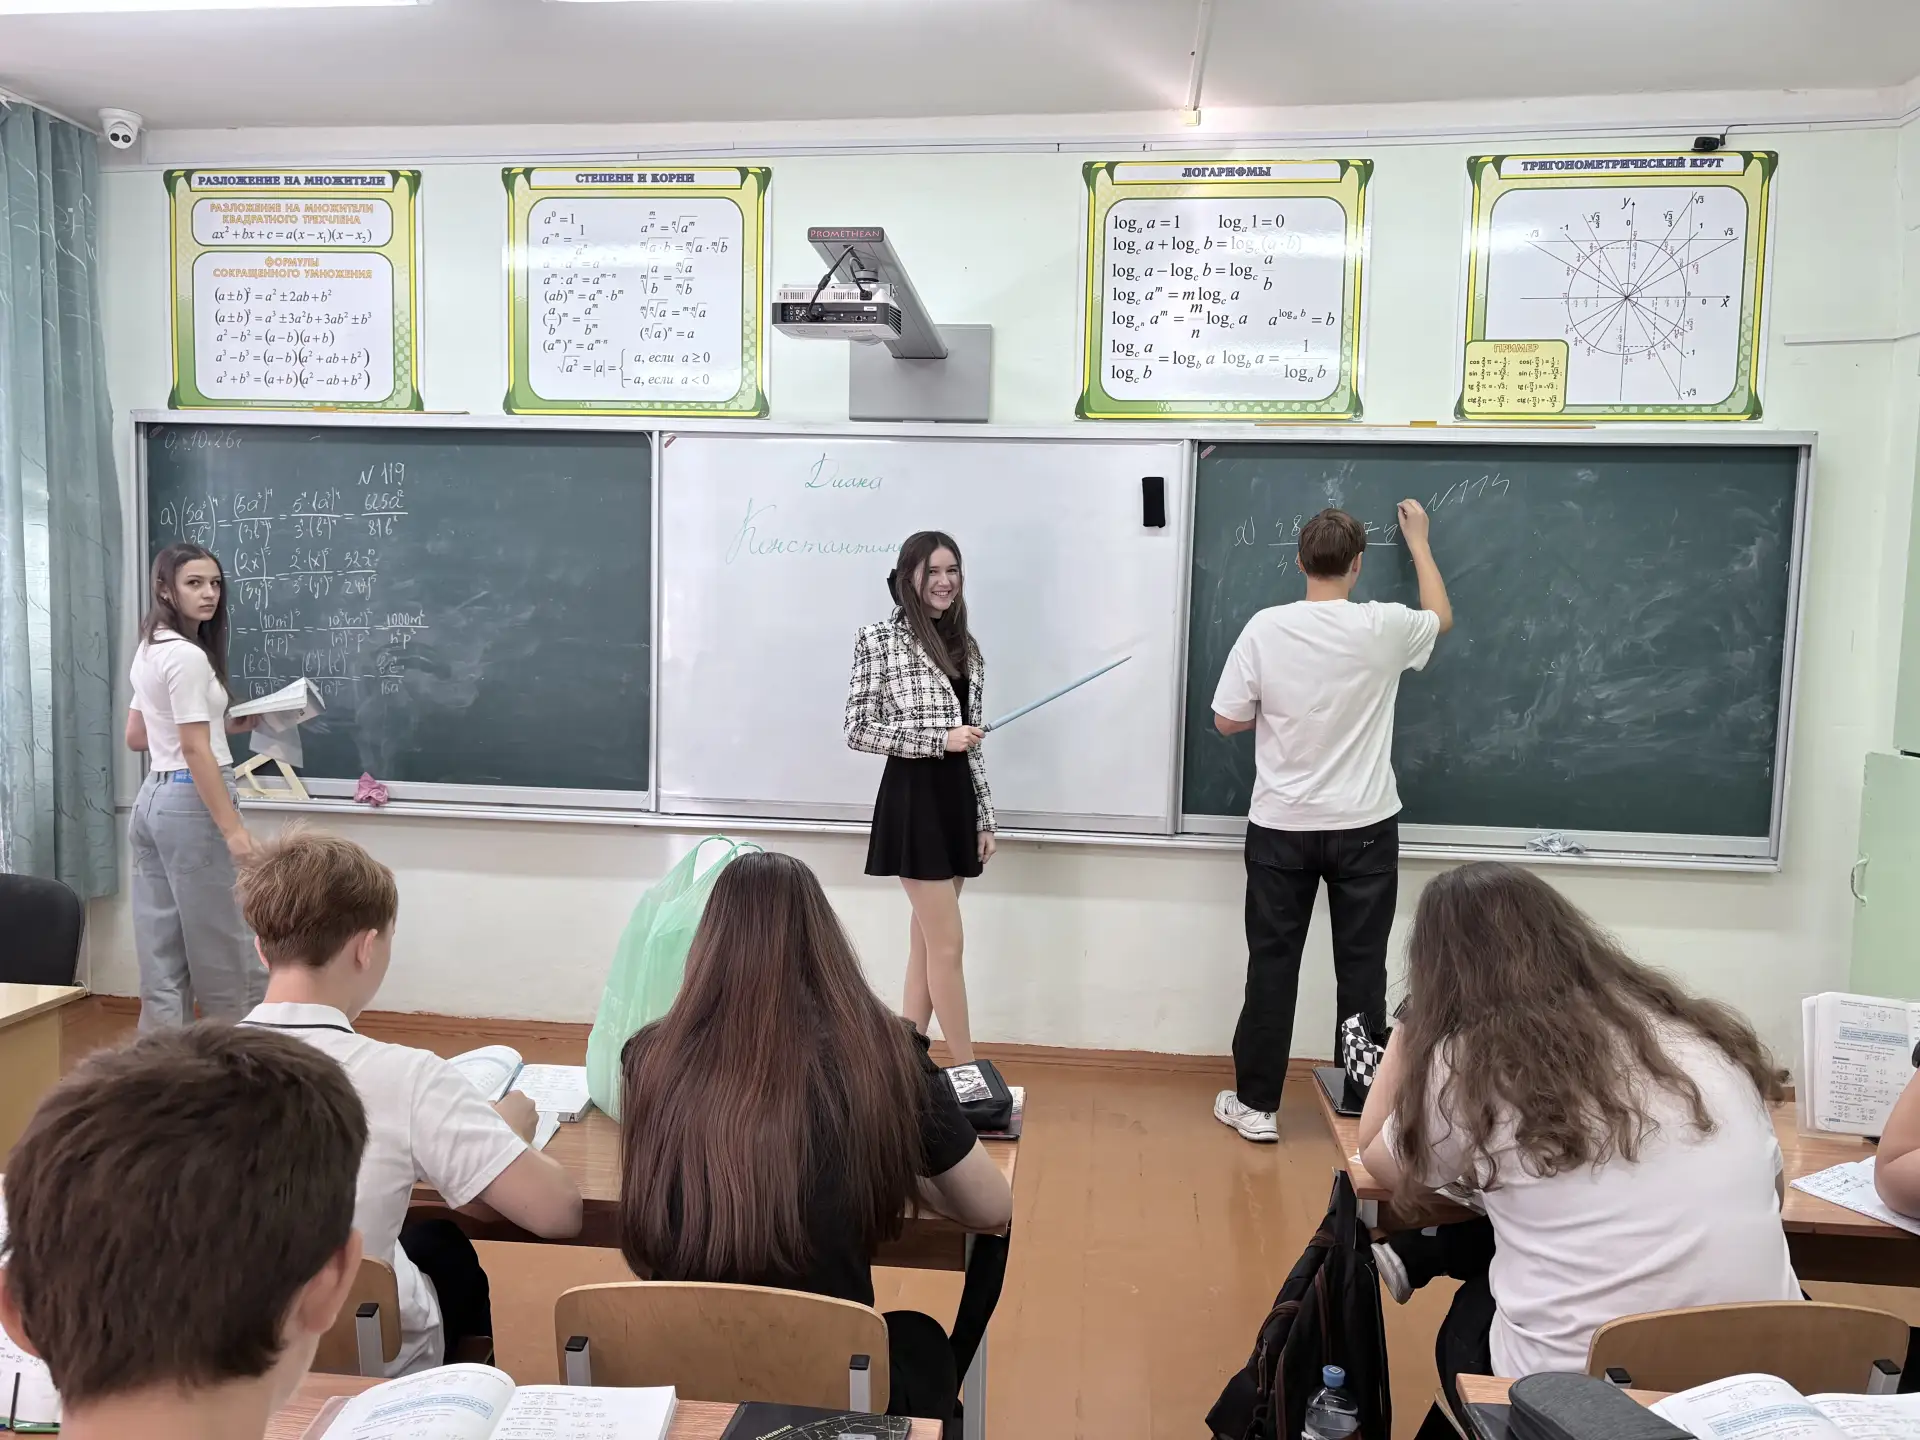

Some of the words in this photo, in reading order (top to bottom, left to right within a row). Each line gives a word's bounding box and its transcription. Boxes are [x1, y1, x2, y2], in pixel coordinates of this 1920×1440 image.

[1522, 158, 1685, 171] ТРИГОНОМЕТРИЧЕСКИЙ
[1689, 158, 1723, 168] КРУГ
[1182, 167, 1271, 177] ЛОГАРИФМЫ
[198, 176, 280, 185] РАЗЛОЖЕНИЕ
[284, 177, 300, 185] НА
[304, 176, 385, 186] МНОЖИТЕЛИ
[575, 174, 634, 183] СТЕПЕНИ
[638, 174, 647, 183] И
[651, 174, 695, 183] КОРНИ
[210, 203, 281, 213] РАЗЛОЖЕНИЕ
[285, 204, 300, 213] НА
[305, 203, 374, 213] МНОЖИТЕЛИ
[222, 215, 298, 224] КВАДРАТНОГО
[303, 215, 361, 224] ТРЕХЧЛЕНА
[810, 230, 880, 238] PROMETHEAN
[265, 257, 319, 267] ФОРМУЛЫ
[213, 268, 300, 278] СОКРАЩЕННОГО
[305, 269, 372, 279] УМНОЖЕНИЯ
[1494, 344, 1539, 352] ПРИМЕР
[805, 453, 883, 489] Диана
[756, 1425, 793, 1440] Дневник
